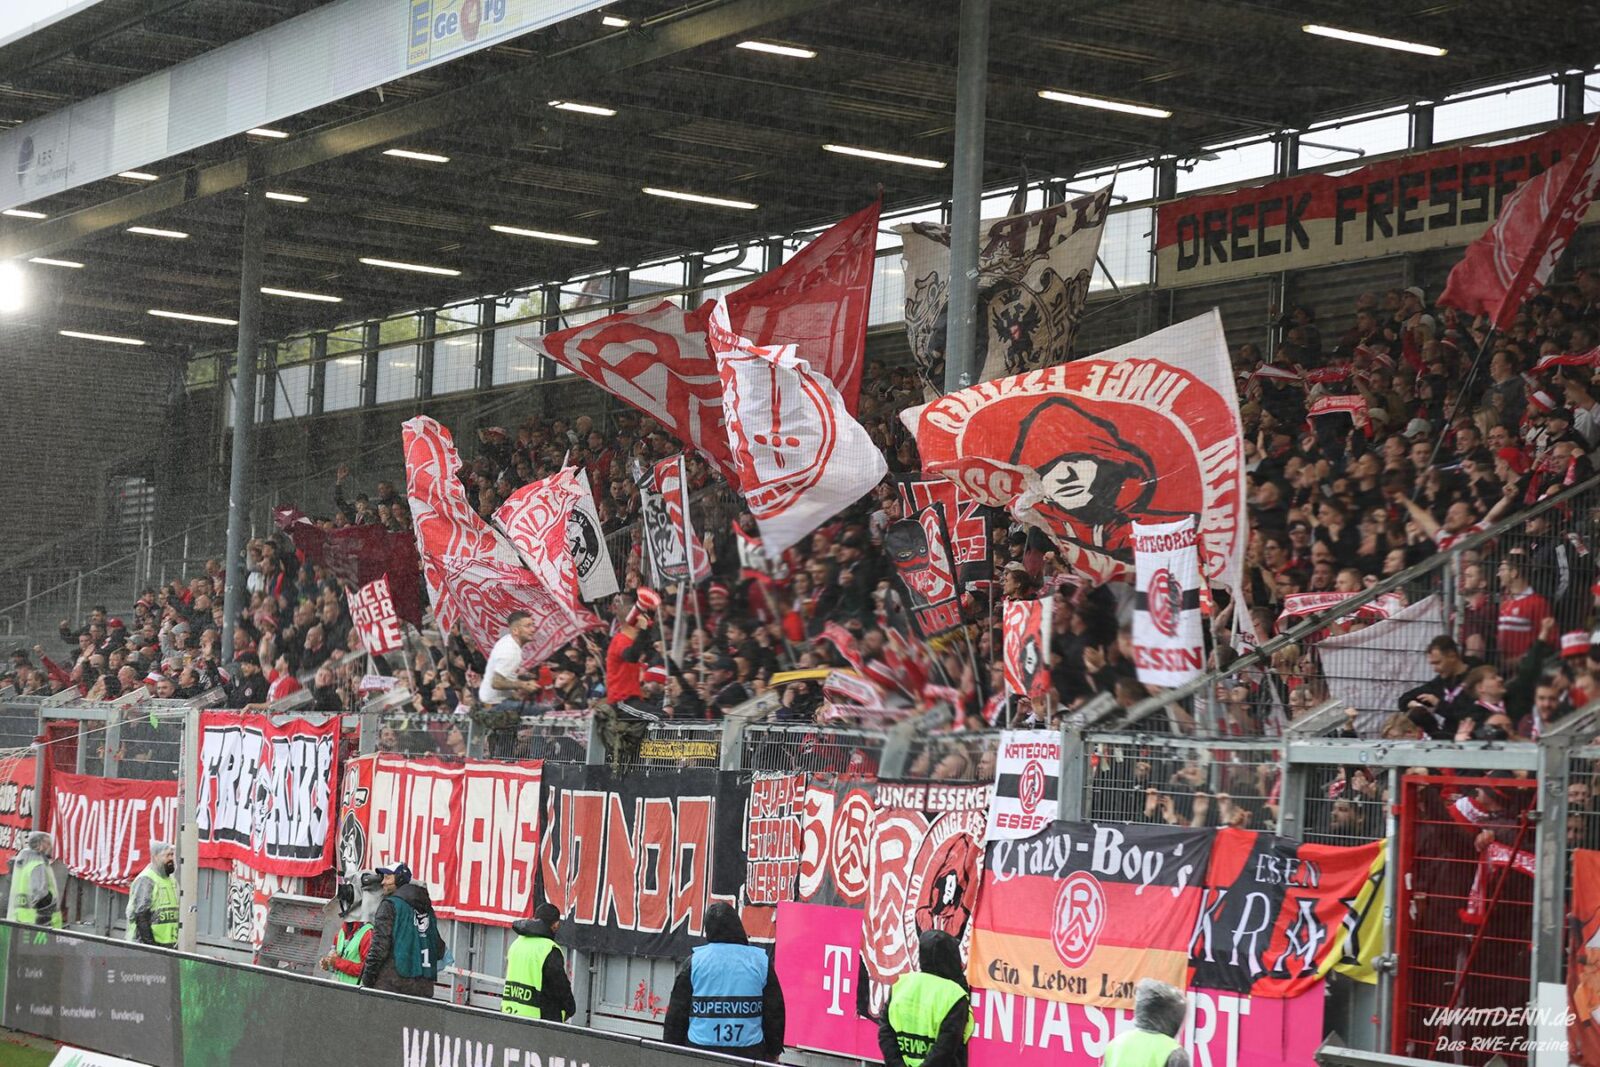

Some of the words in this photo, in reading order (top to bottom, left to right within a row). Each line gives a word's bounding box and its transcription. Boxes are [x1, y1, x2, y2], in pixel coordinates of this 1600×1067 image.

[1177, 192, 1310, 272] DRECK
[874, 784, 926, 808] JUNGE
[996, 813, 1049, 830] ESSE
[420, 948, 432, 968] 1
[988, 958, 1020, 985] Ein
[1032, 965, 1088, 995] Leben
[1101, 973, 1137, 998] Lan
[692, 1001, 763, 1014] SUPERVISOR
[713, 1023, 744, 1042] 137
